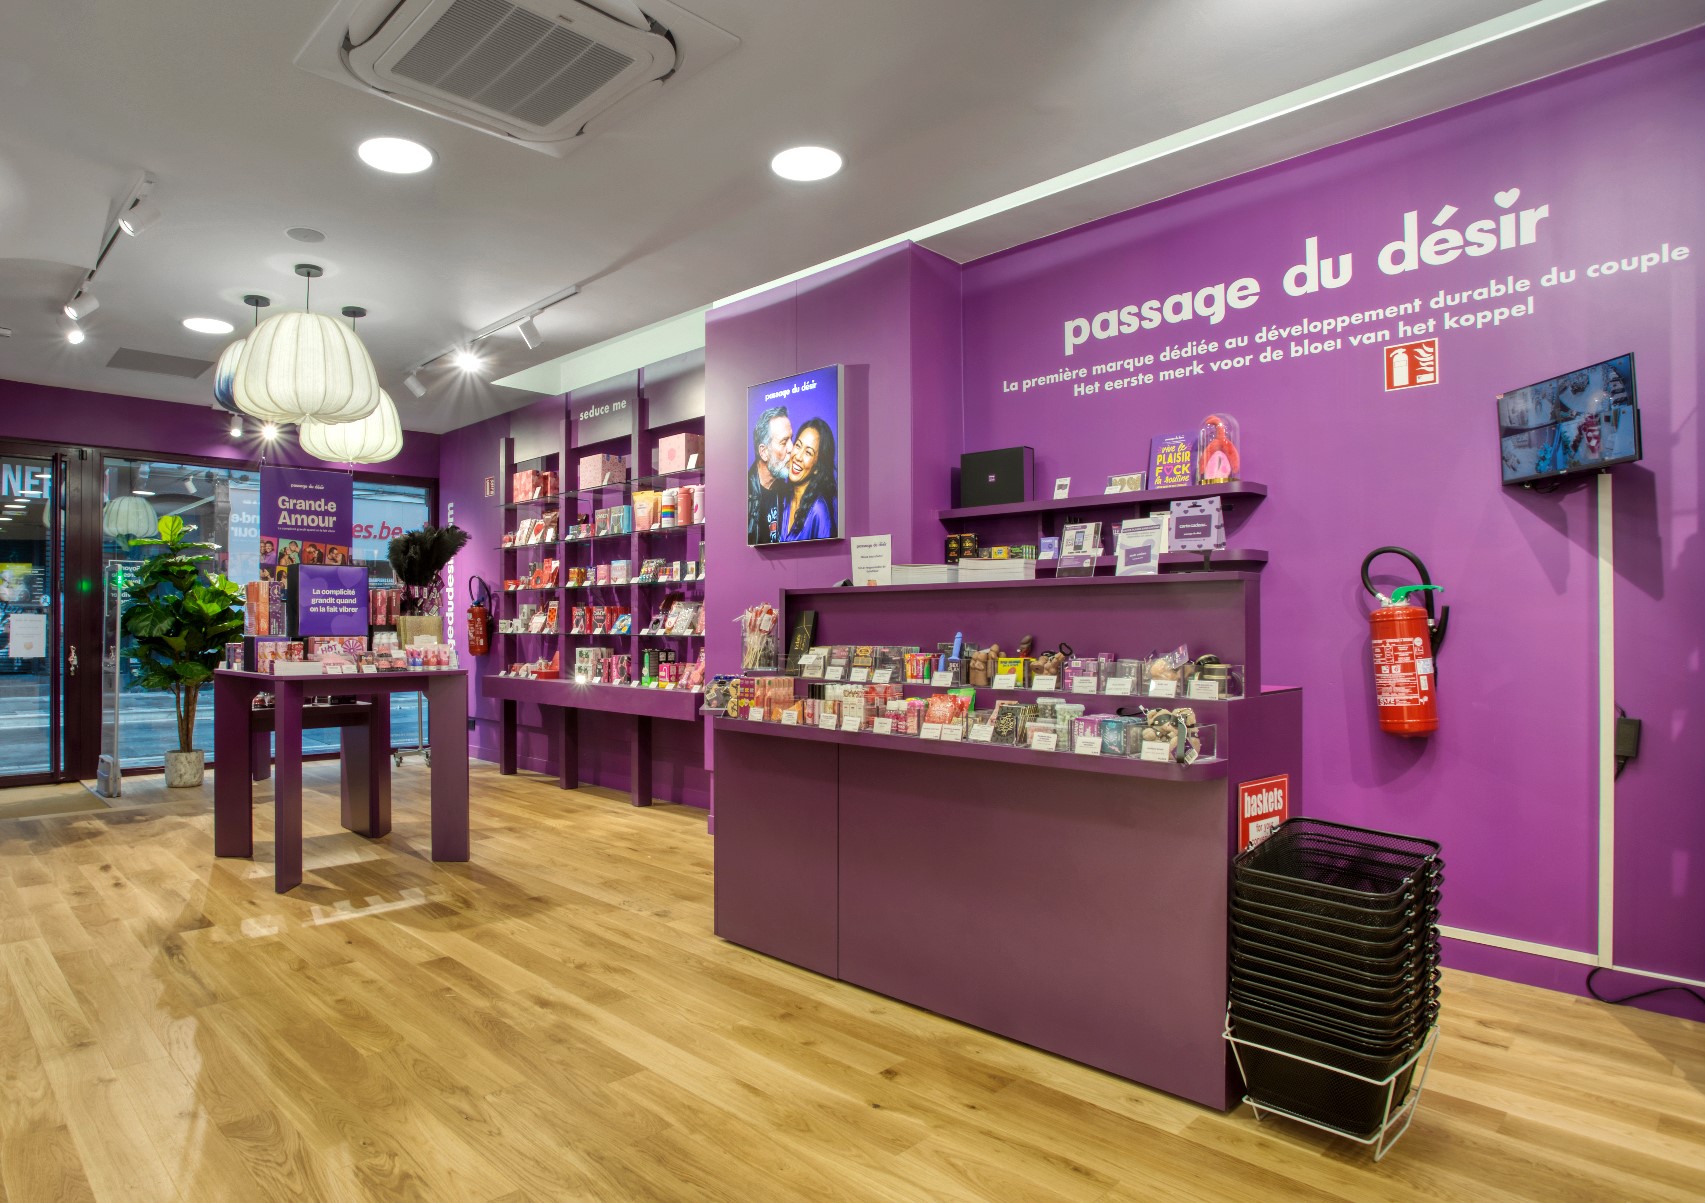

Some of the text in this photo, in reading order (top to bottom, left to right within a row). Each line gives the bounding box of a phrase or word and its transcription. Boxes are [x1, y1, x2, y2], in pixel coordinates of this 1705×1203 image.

[1064, 188, 1549, 356] passage du désir
[1003, 243, 1690, 393] La première marque dédiée au développement durable du couple
[1073, 295, 1534, 397] Het eerste merk voor de bloei van het koppel
[765, 379, 817, 402] passage du désir
[579, 399, 627, 420] seduce me
[1156, 450, 1191, 466] PLAISIR
[1161, 445, 1176, 454] vive
[277, 510, 337, 528] Amour
[352, 520, 403, 540] es.be
[321, 588, 356, 596] complicité
[336, 597, 357, 605] quand
[320, 644, 337, 654] HOT
[1244, 787, 1284, 819] baskets
